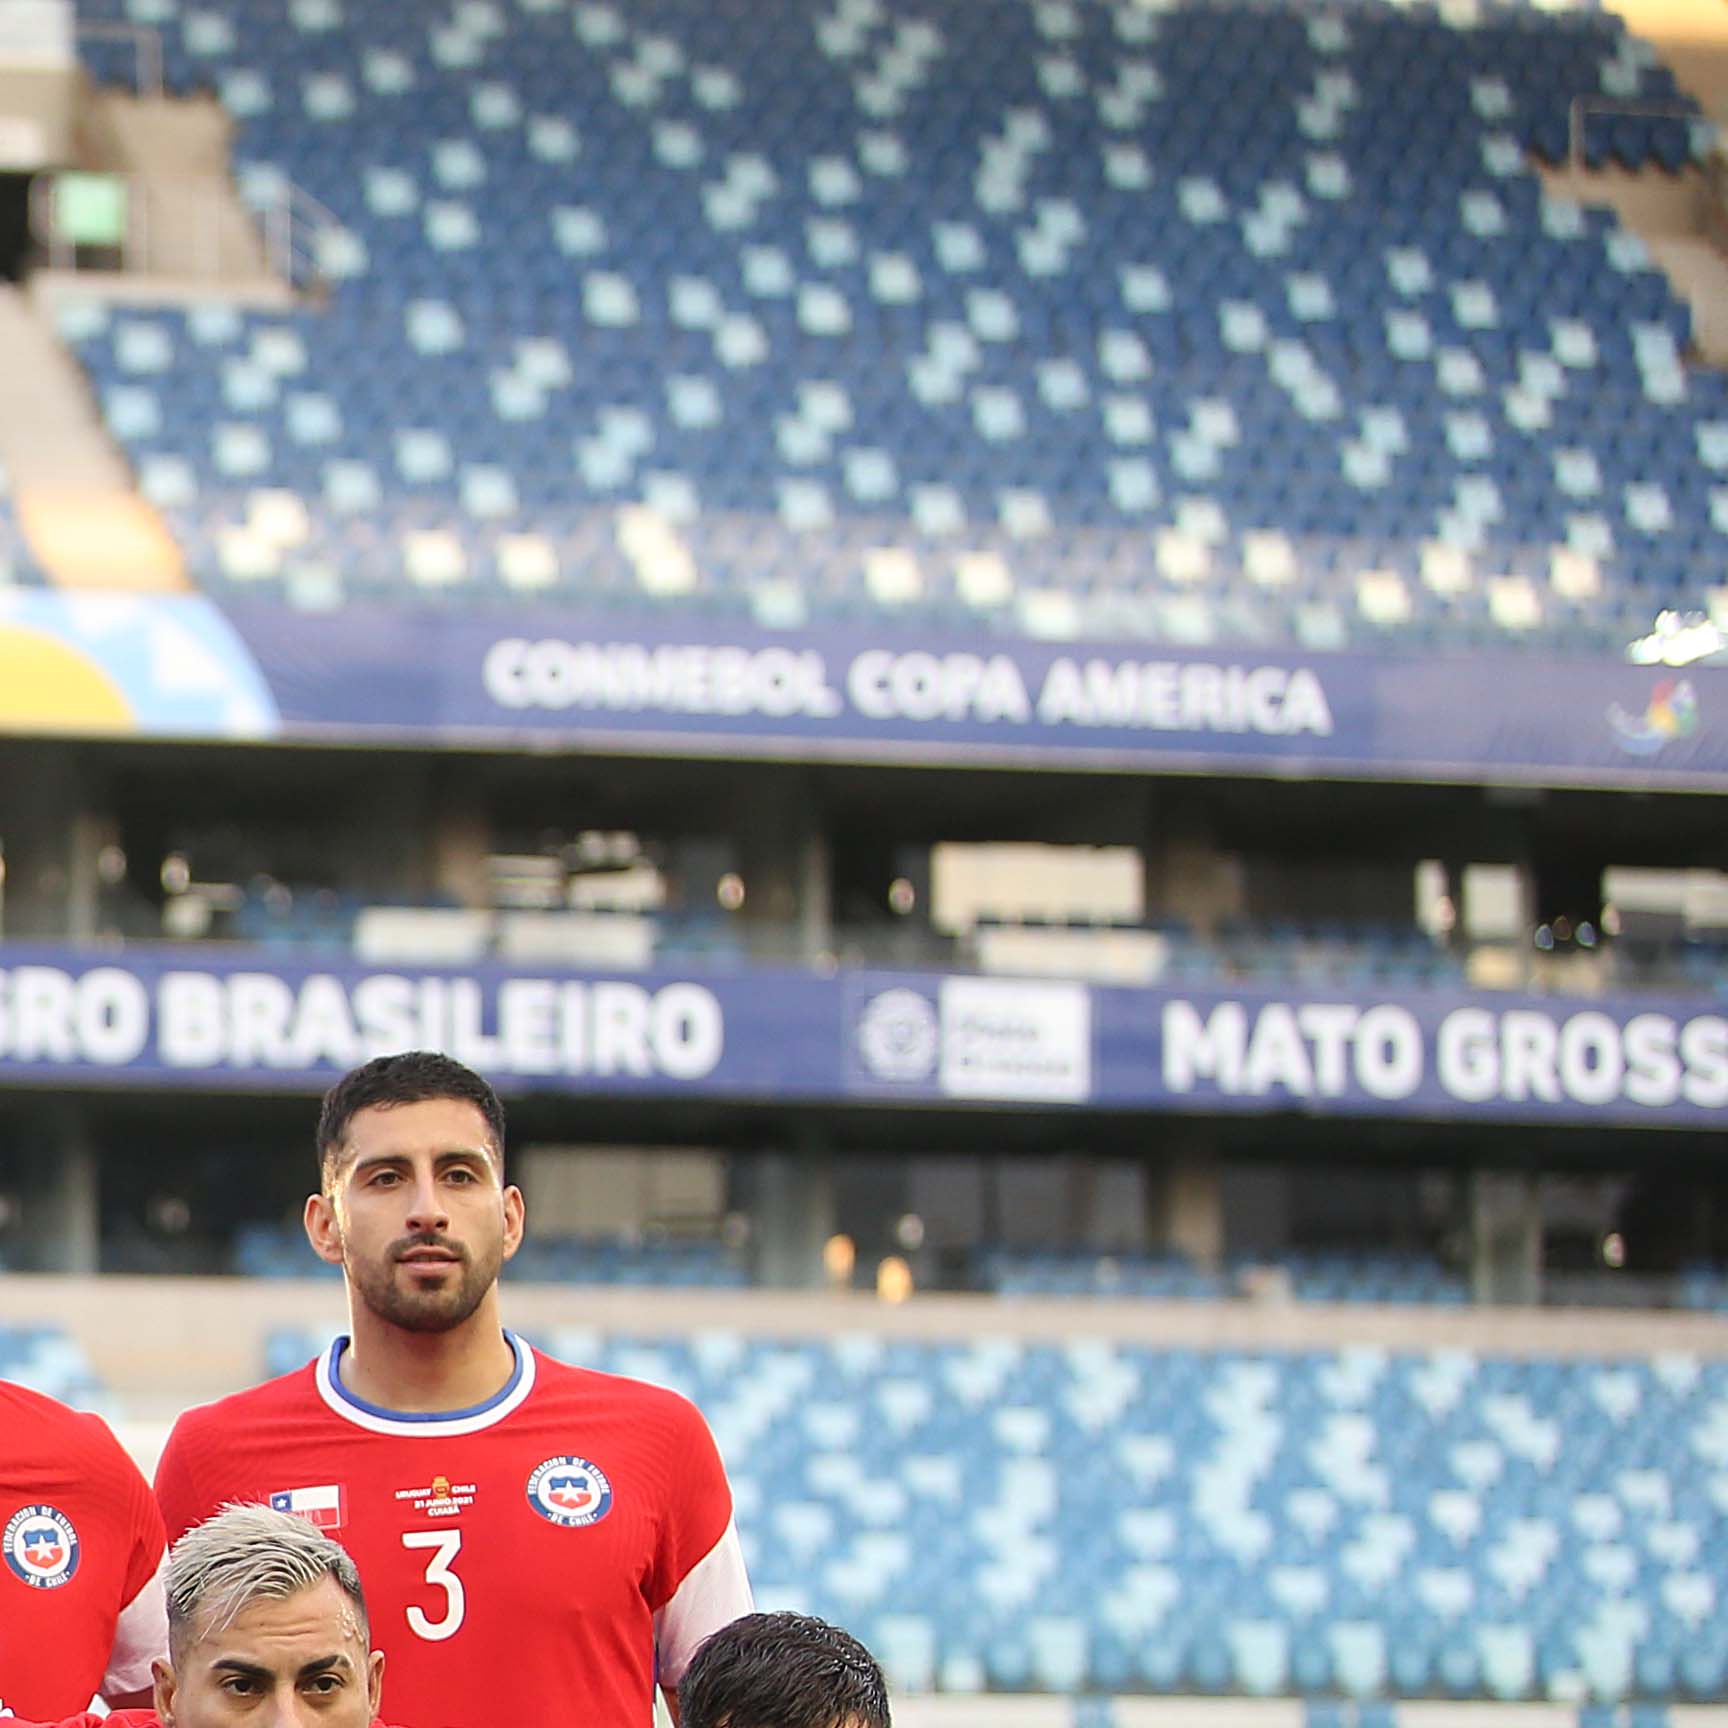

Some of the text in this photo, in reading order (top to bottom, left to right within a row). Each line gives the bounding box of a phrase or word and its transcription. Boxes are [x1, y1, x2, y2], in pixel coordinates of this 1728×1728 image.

[484, 639, 1334, 738] CONMEBOL COPA AMERICA
[156, 970, 724, 1081] BRASILEIRO
[1161, 1000, 1424, 1100] MATO
[402, 1530, 466, 1641] 3
